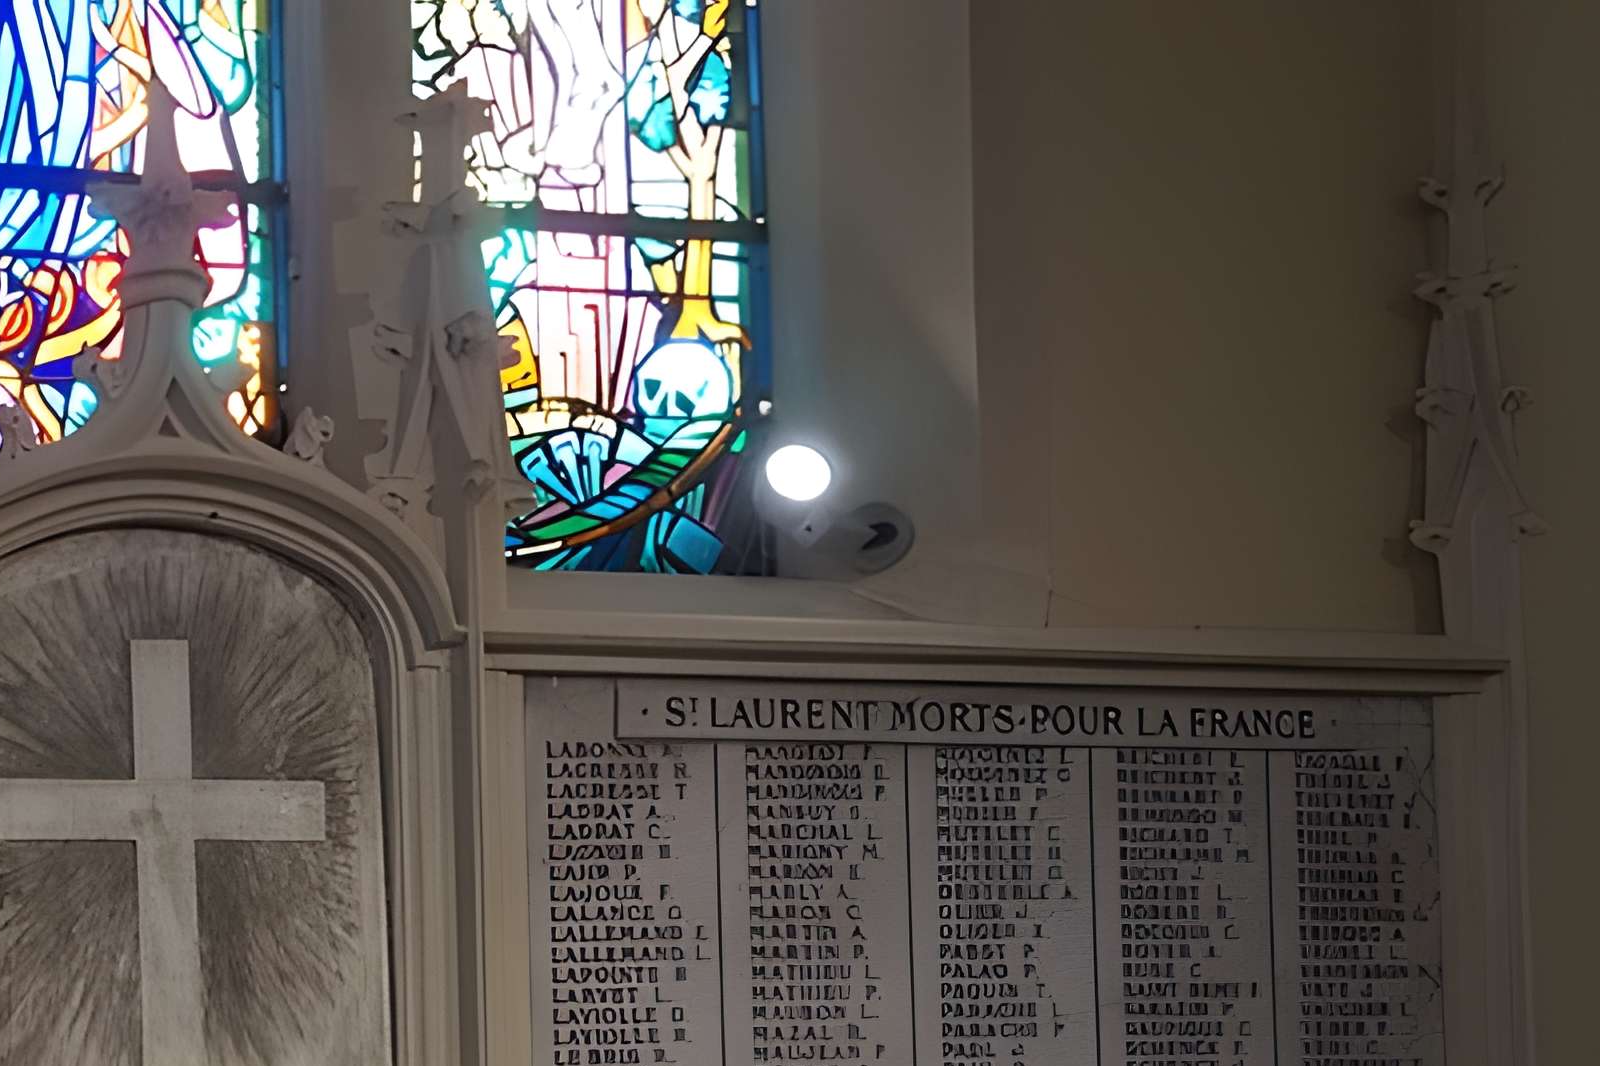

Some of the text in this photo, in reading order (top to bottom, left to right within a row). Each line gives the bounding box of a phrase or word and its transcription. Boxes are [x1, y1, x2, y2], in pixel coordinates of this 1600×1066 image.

[711, 697, 880, 731] LAURENT
[889, 697, 1013, 733] MORTS
[1030, 702, 1124, 737] POUR
[1138, 708, 1179, 737] LA
[1190, 708, 1316, 740] FRANCE
